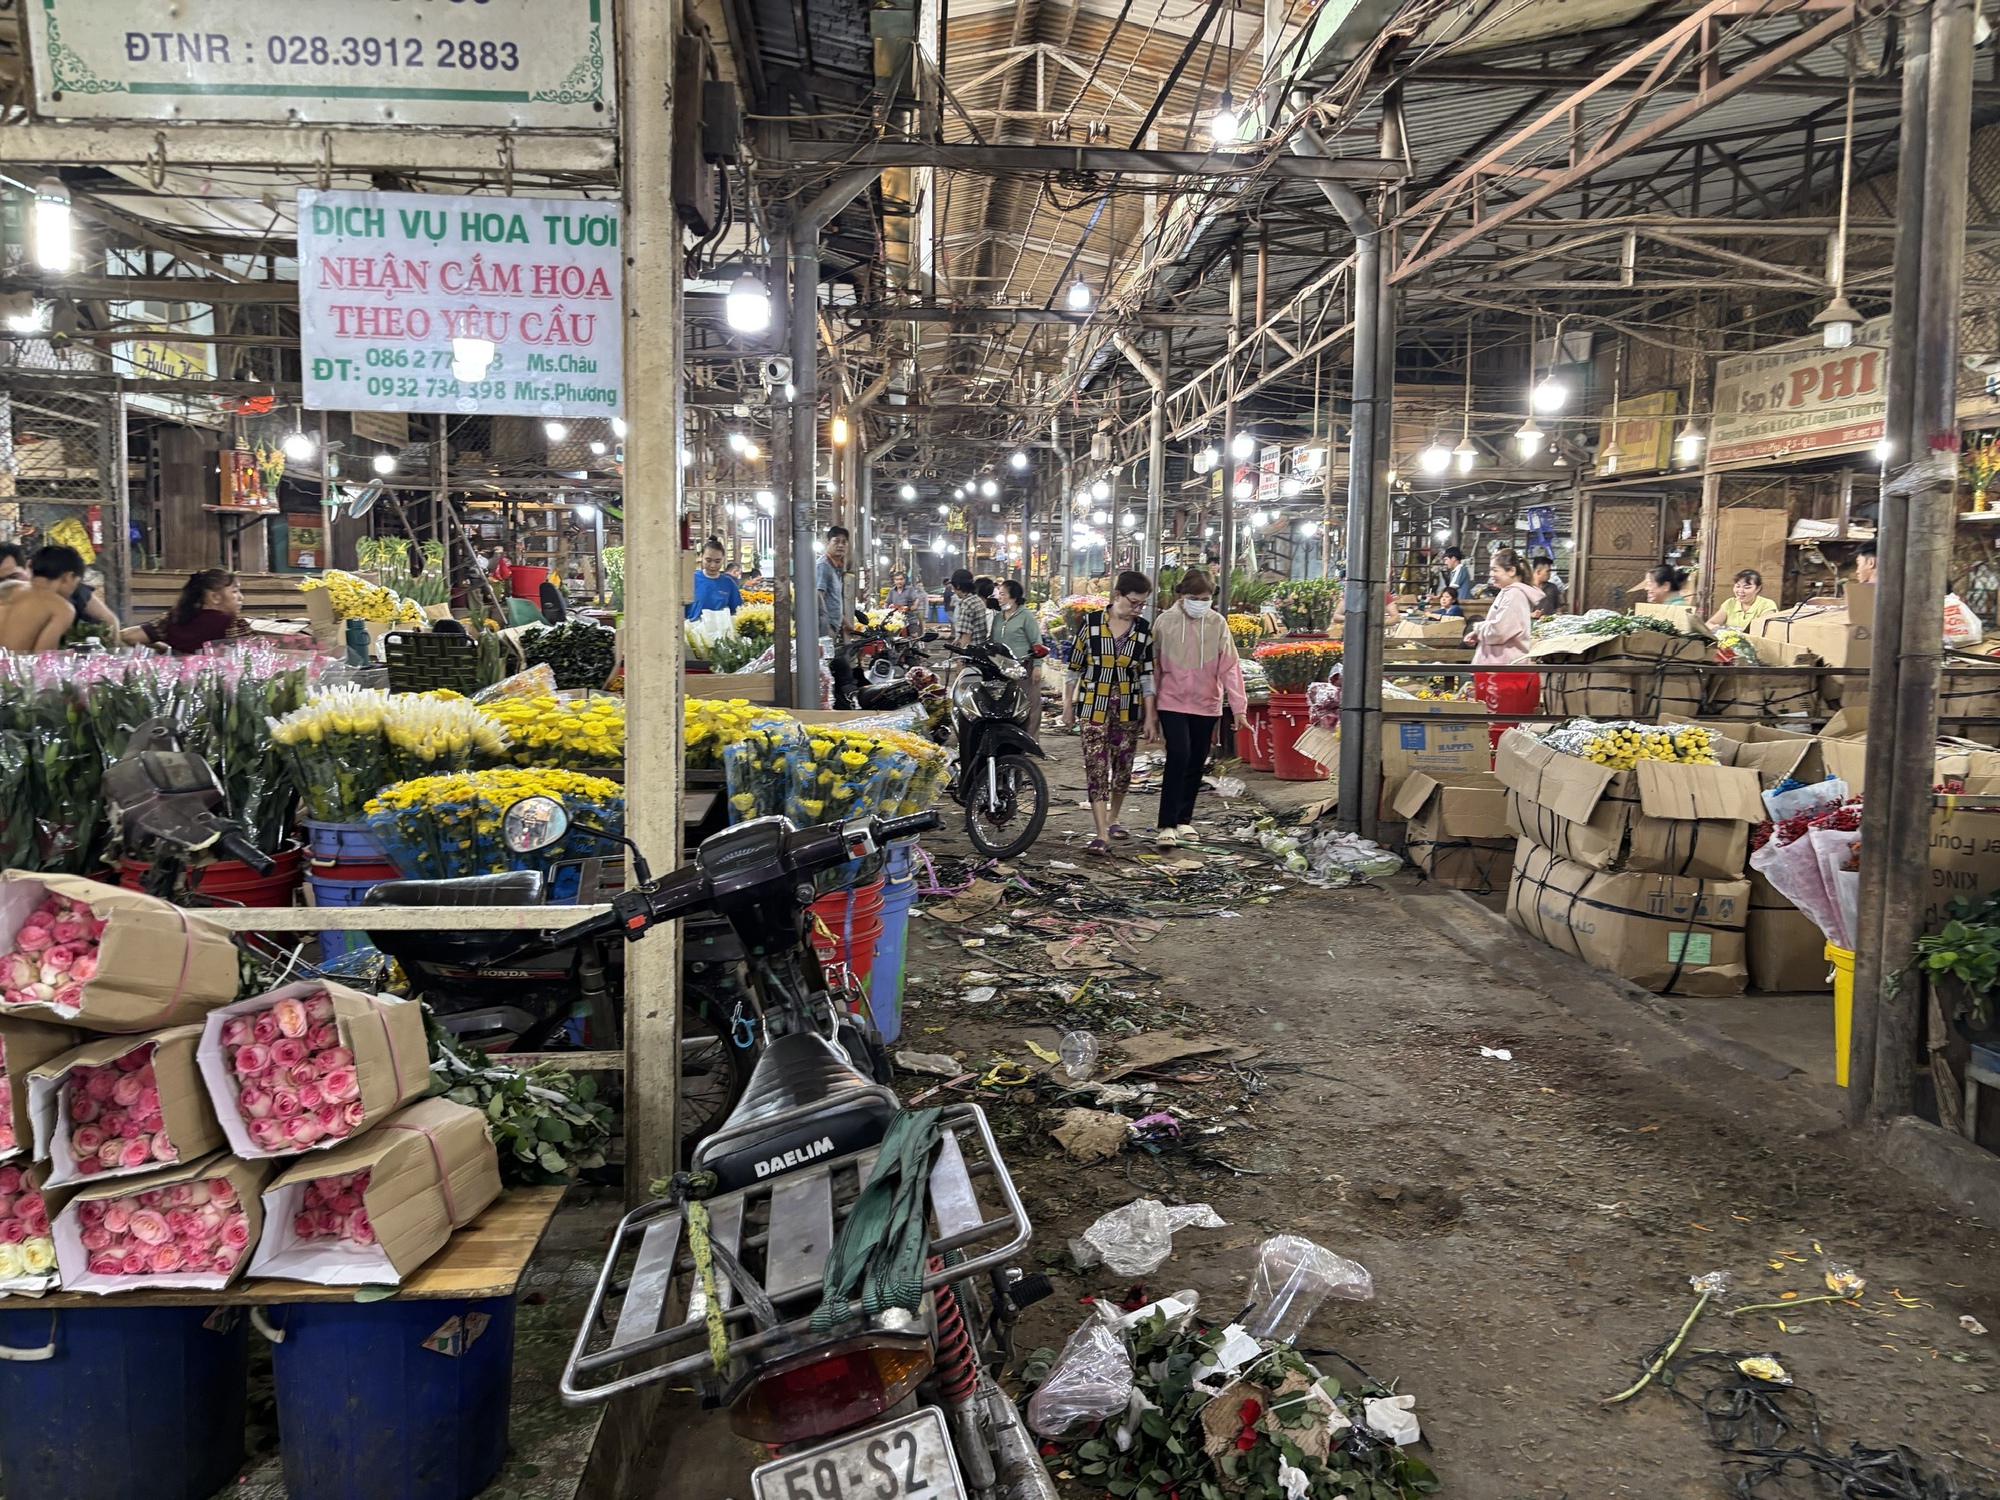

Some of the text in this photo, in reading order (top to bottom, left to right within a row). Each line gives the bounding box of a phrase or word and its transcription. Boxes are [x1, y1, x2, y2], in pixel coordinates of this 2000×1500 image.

[125, 32, 231, 63] ĐTNR
[267, 35, 424, 67] 028.3912
[437, 38, 519, 71] 2883
[312, 206, 617, 247] DỊCH VỤ HOA TƯƠI
[318, 252, 614, 300] NHẬN CẮM HOA
[328, 303, 596, 346] THEO YÊU CẦU
[311, 357, 361, 382] ĐT:
[366, 348, 409, 370] 086
[527, 353, 597, 374] Ms.Châu
[1788, 352, 1878, 408] PHI
[367, 376, 617, 407] 0932 734 398 Mrs.Phương
[1932, 868, 1979, 891] KING
[754, 1136, 835, 1178] DAELIM
[783, 1430, 928, 1500] 59-S2
